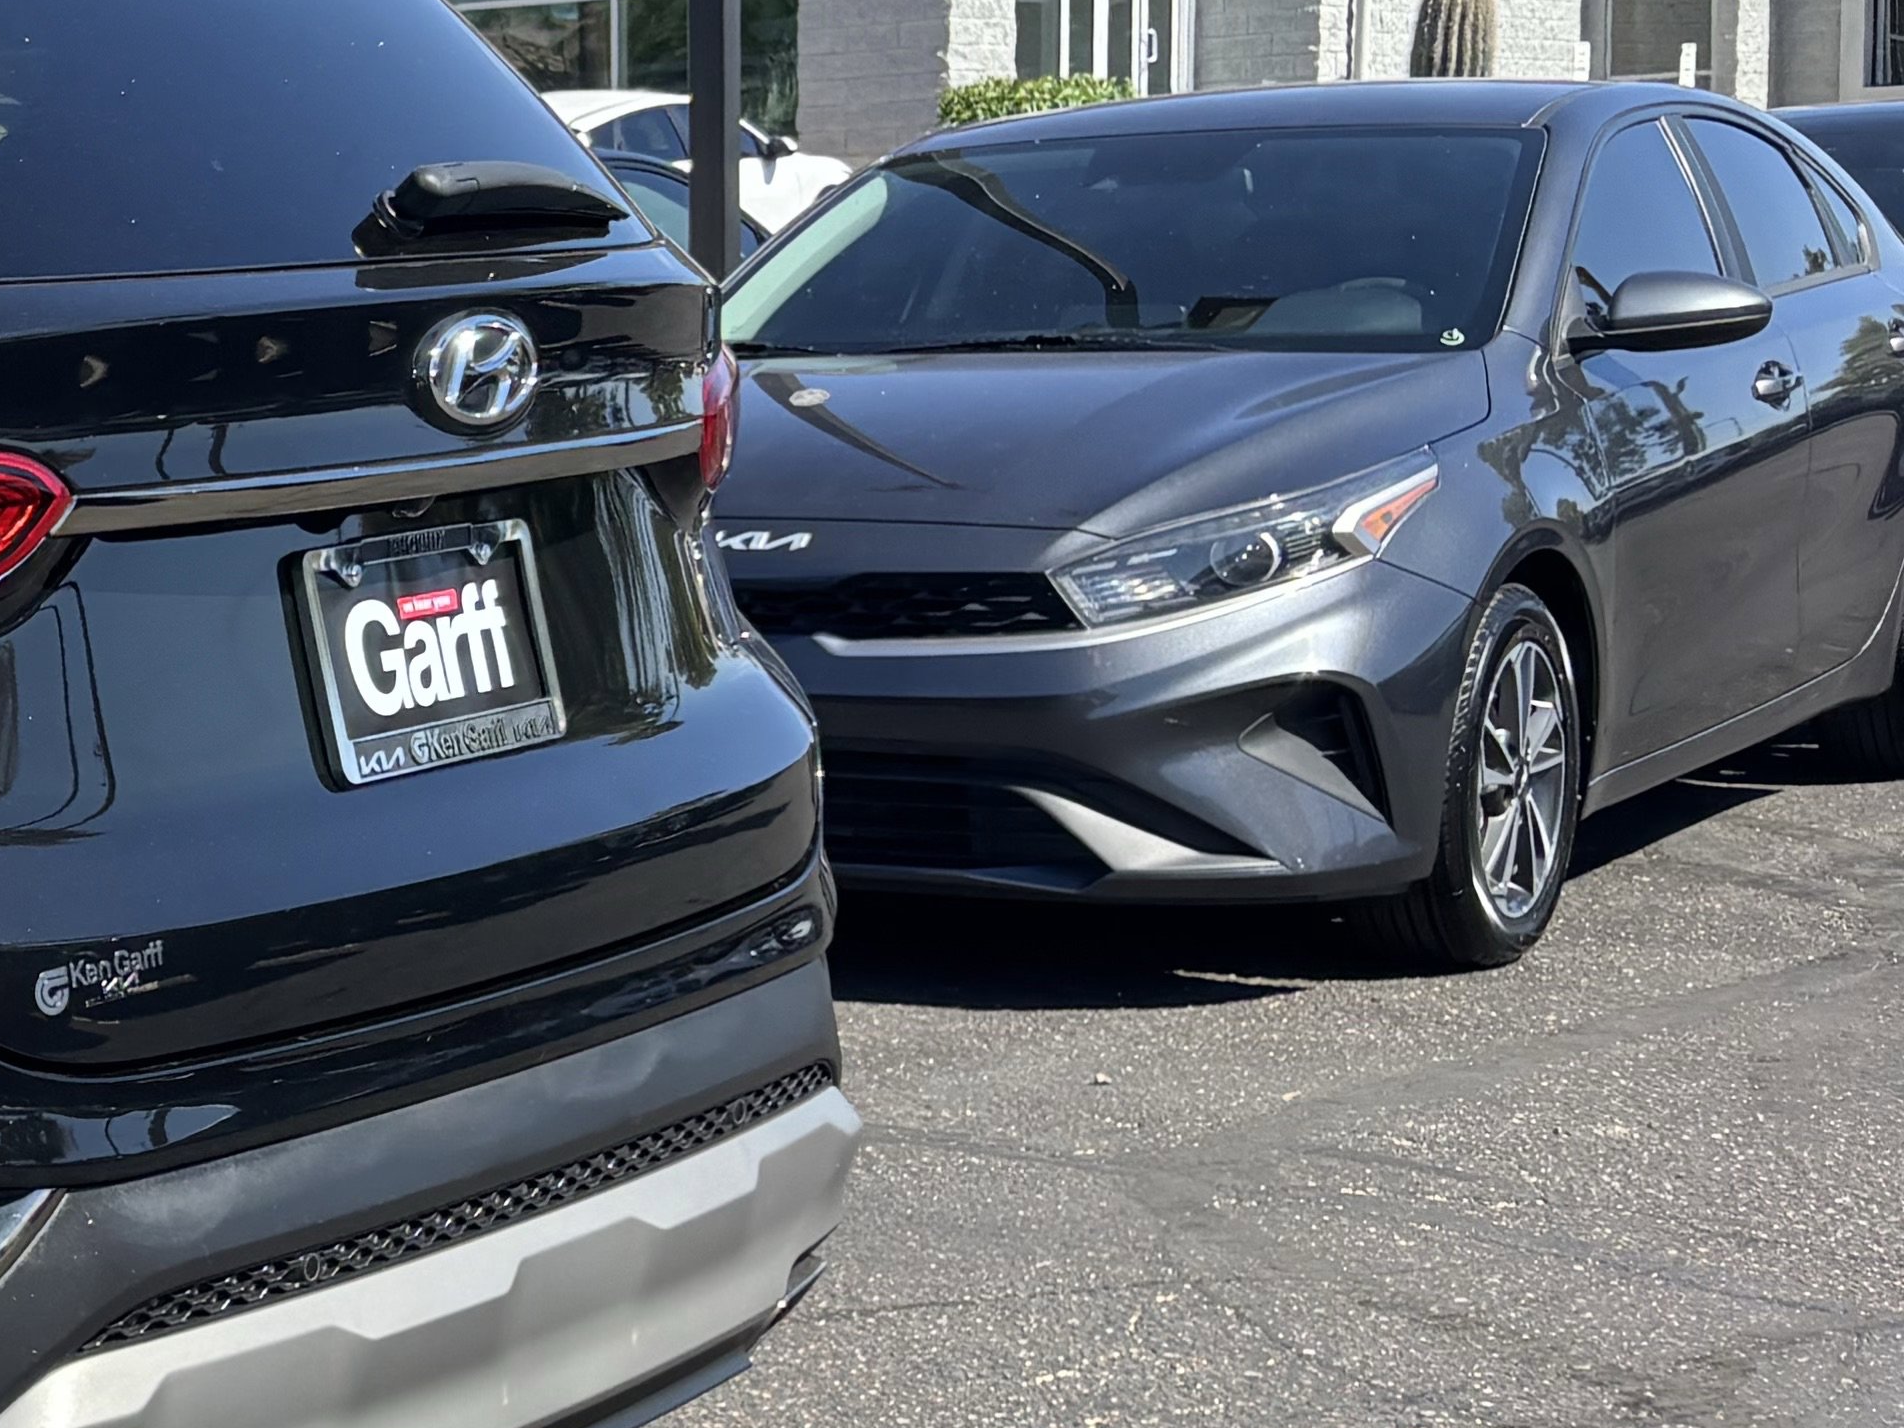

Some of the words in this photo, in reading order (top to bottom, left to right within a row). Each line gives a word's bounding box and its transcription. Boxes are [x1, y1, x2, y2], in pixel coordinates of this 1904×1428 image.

[345, 579, 516, 716] Garff
[69, 959, 111, 988] Ken
[114, 940, 165, 974] Garff
